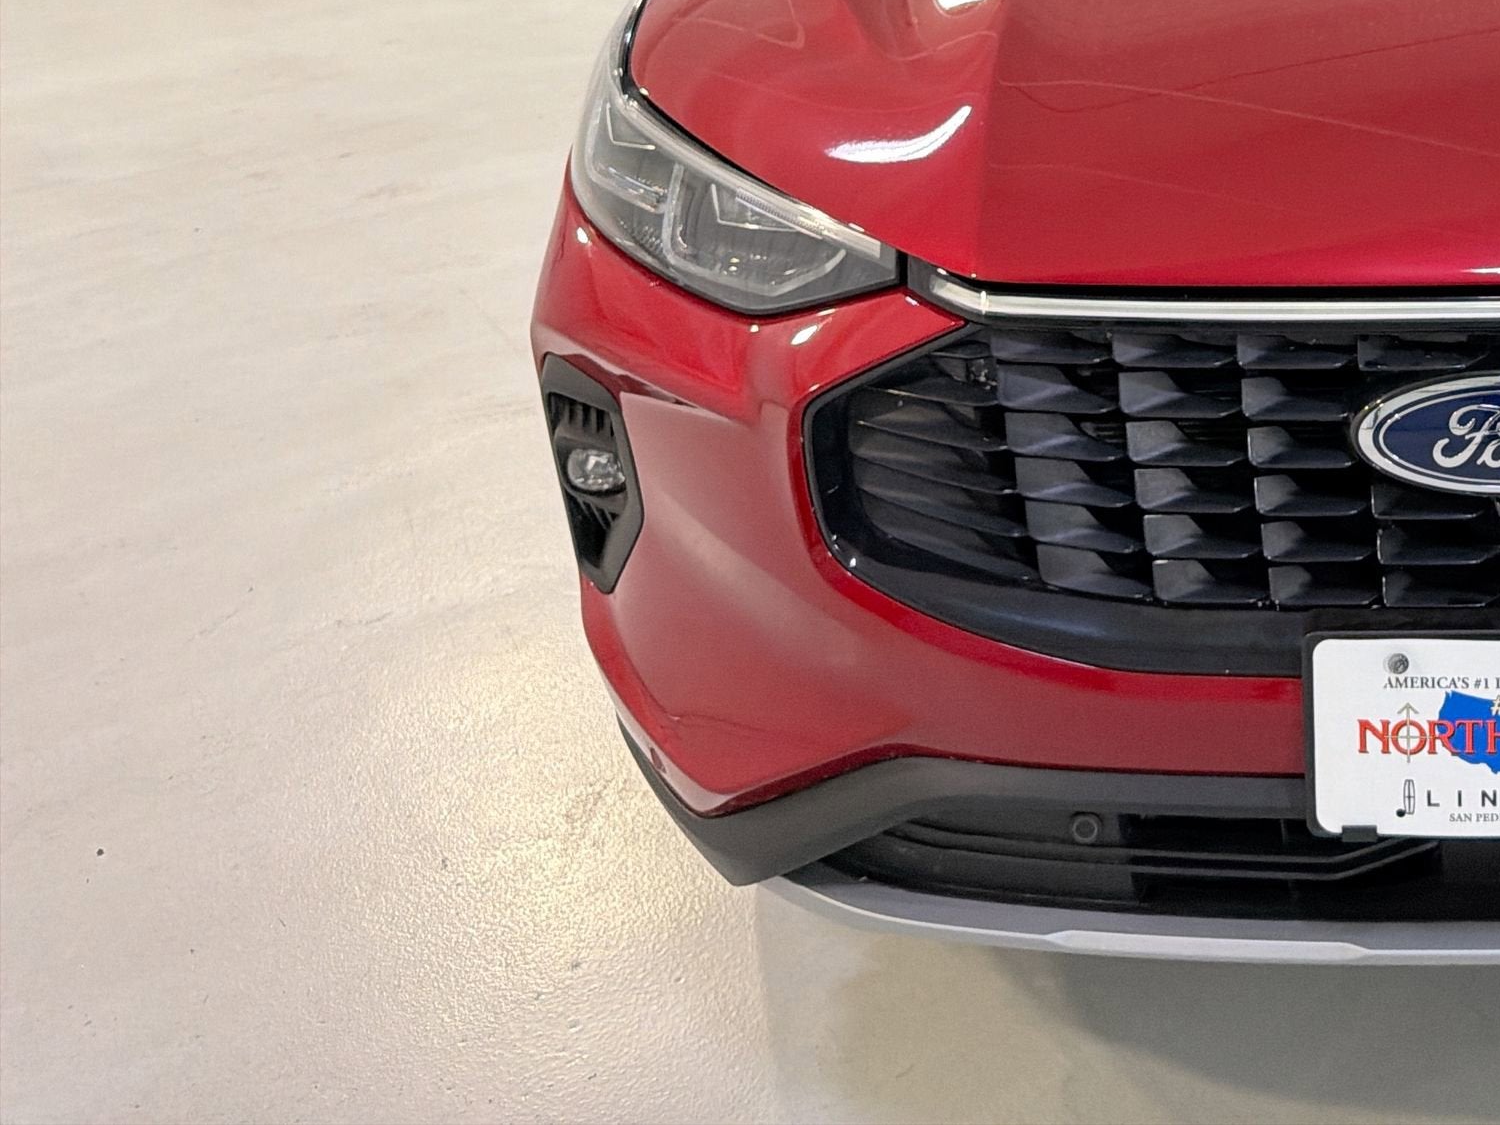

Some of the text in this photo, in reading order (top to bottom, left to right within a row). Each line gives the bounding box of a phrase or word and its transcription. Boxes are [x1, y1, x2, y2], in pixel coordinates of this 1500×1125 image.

[1384, 676, 1471, 690] AMERICA'S
[1474, 676, 1490, 689] #1
[1449, 812, 1473, 823] SAN
